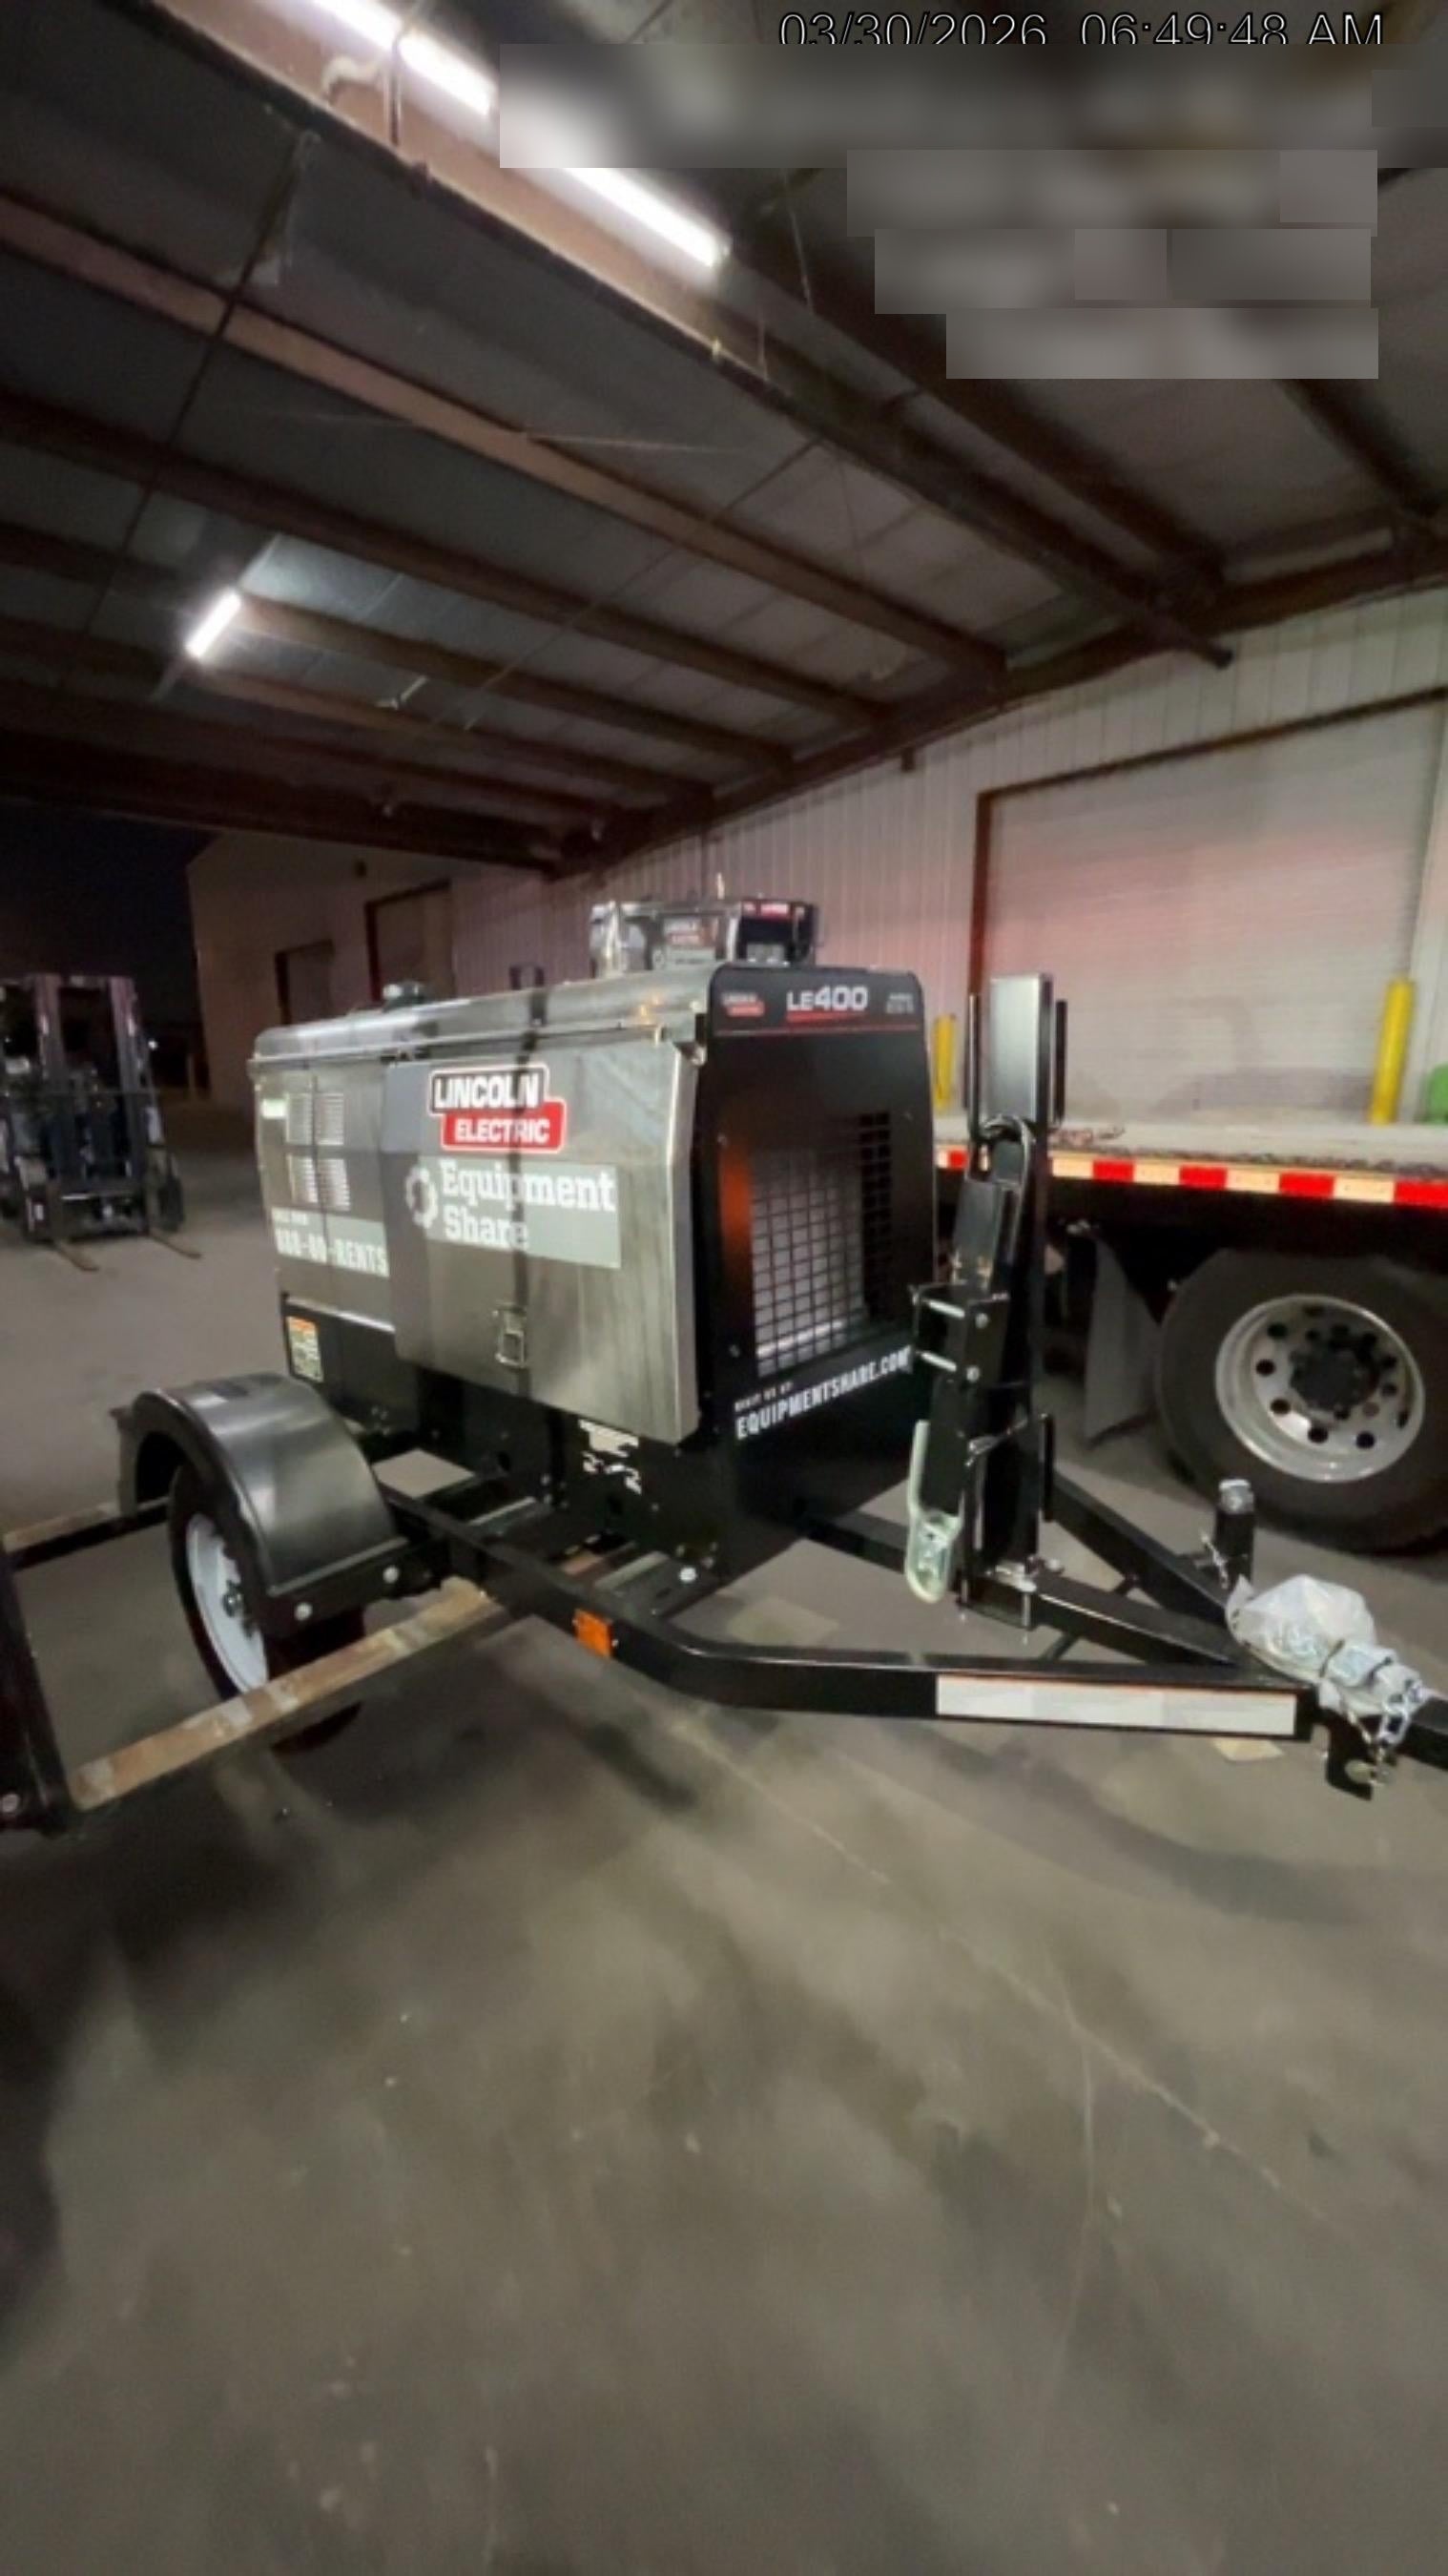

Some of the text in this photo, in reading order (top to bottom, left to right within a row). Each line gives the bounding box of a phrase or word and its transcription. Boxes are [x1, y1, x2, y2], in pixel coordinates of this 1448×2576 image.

[786, 985, 869, 1012] LE400
[433, 1072, 540, 1109] LINCOLN
[453, 1117, 550, 1143] ELECTRIC
[440, 1158, 617, 1213] Equipment
[443, 1204, 530, 1251] Share
